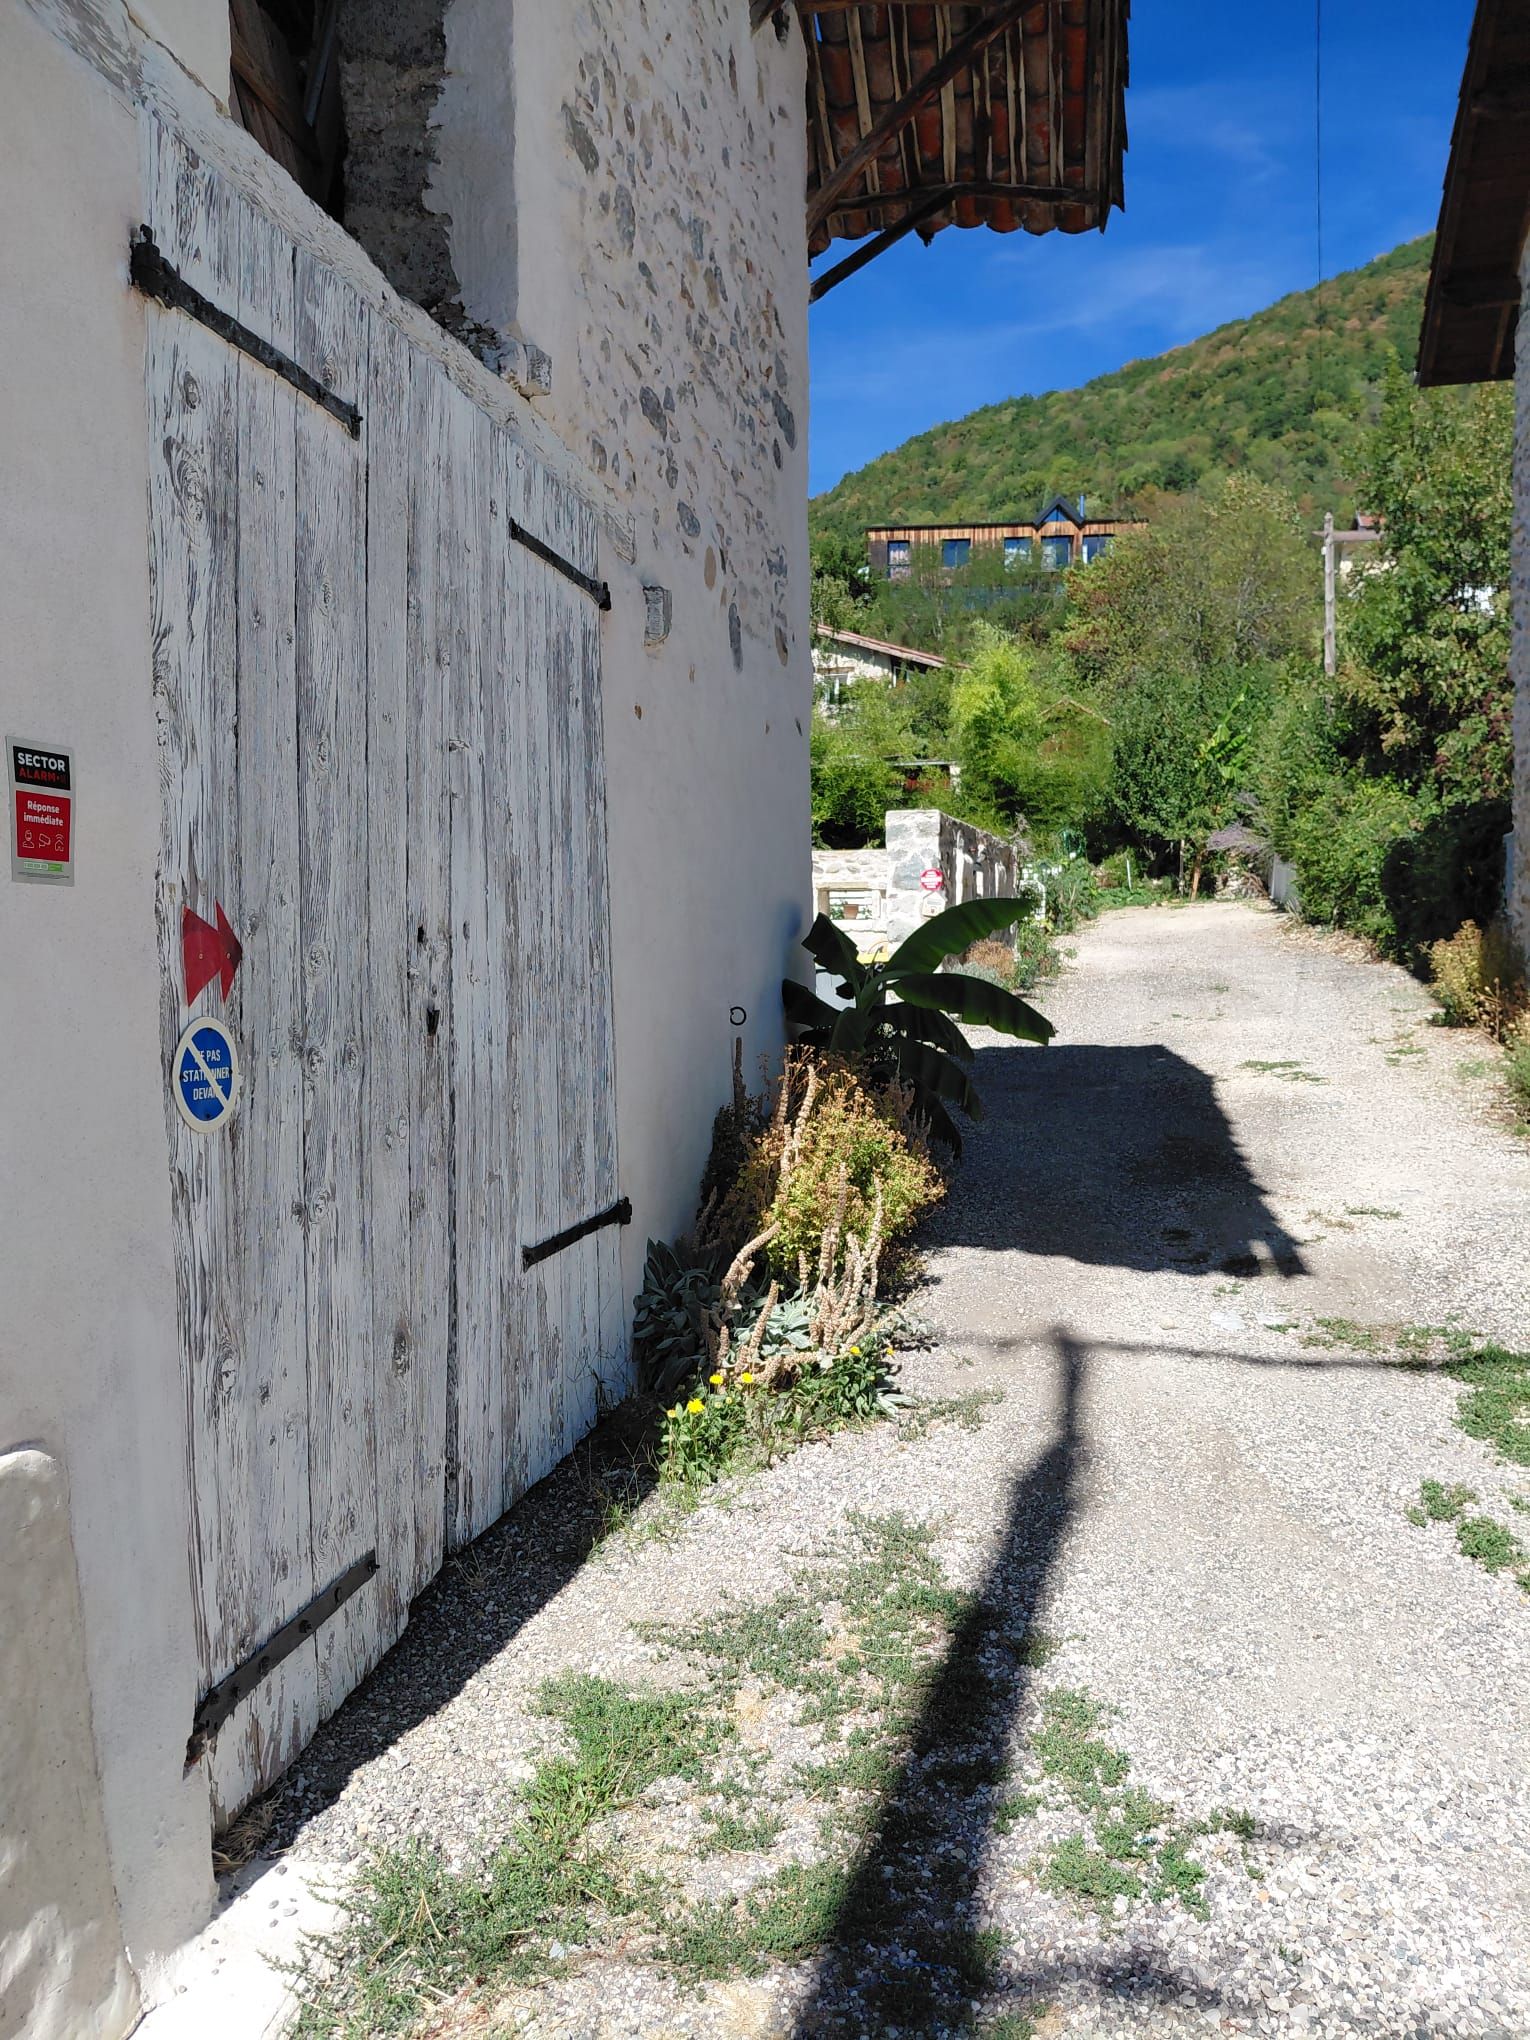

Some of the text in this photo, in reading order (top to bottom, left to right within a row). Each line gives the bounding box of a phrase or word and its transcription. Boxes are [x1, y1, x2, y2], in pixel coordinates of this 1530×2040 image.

[17, 752, 65, 772] SECTOR
[19, 767, 56, 782] ALARM
[27, 800, 60, 814] Réponse
[23, 812, 64, 826] immédiate
[206, 1049, 221, 1062] PAS
[193, 1086, 223, 1100] DEVA
